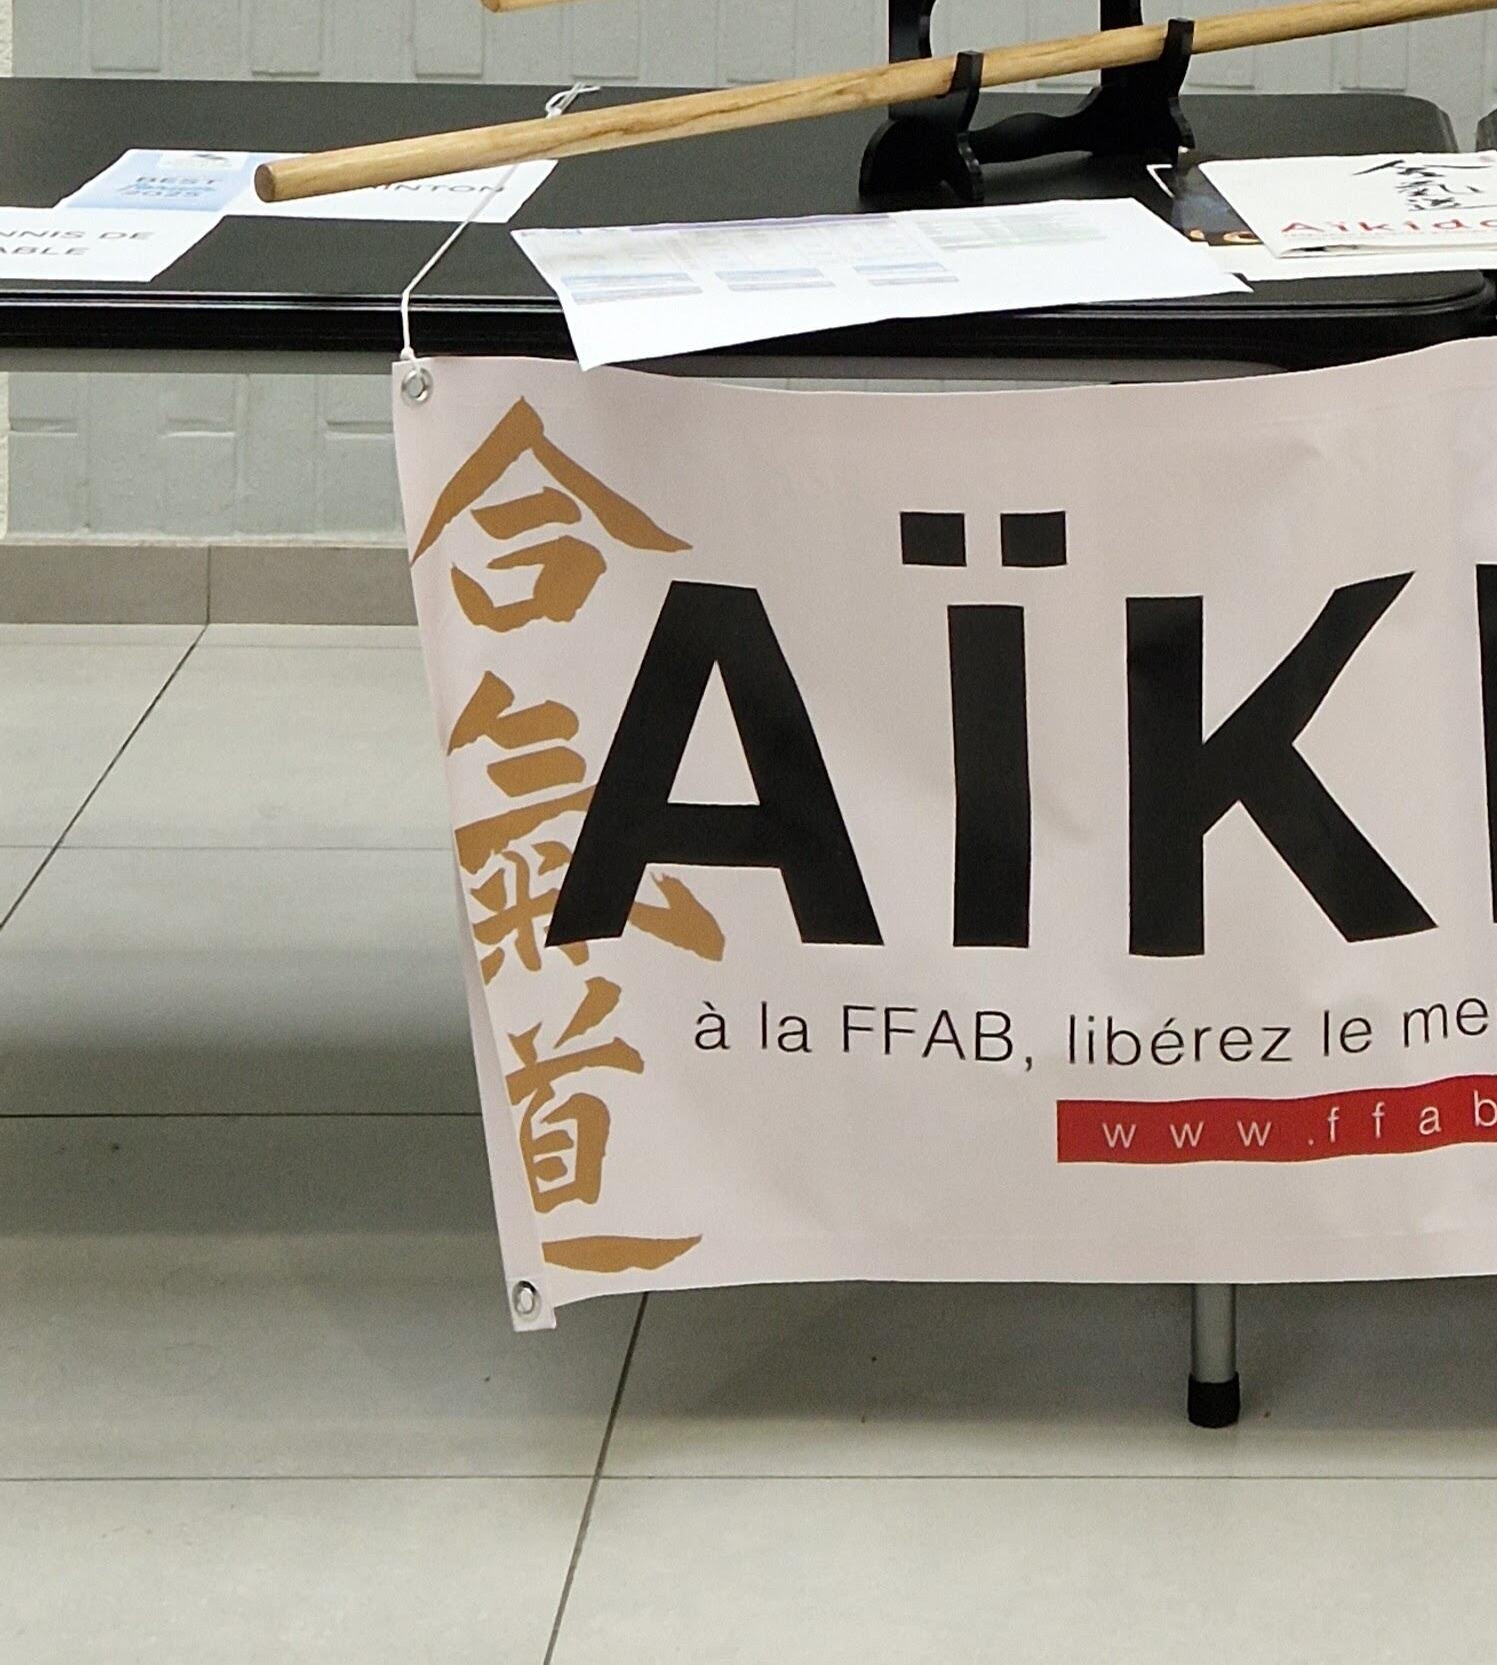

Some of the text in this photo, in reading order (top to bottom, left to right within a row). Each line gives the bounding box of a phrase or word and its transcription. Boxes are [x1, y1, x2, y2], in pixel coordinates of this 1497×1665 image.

[98, 230, 156, 240] DE
[694, 999, 730, 1051] à
[761, 1000, 812, 1054] la
[842, 1003, 1033, 1072] FFAB,
[1068, 1013, 1293, 1068] libérez
[1323, 1009, 1373, 1058] le
